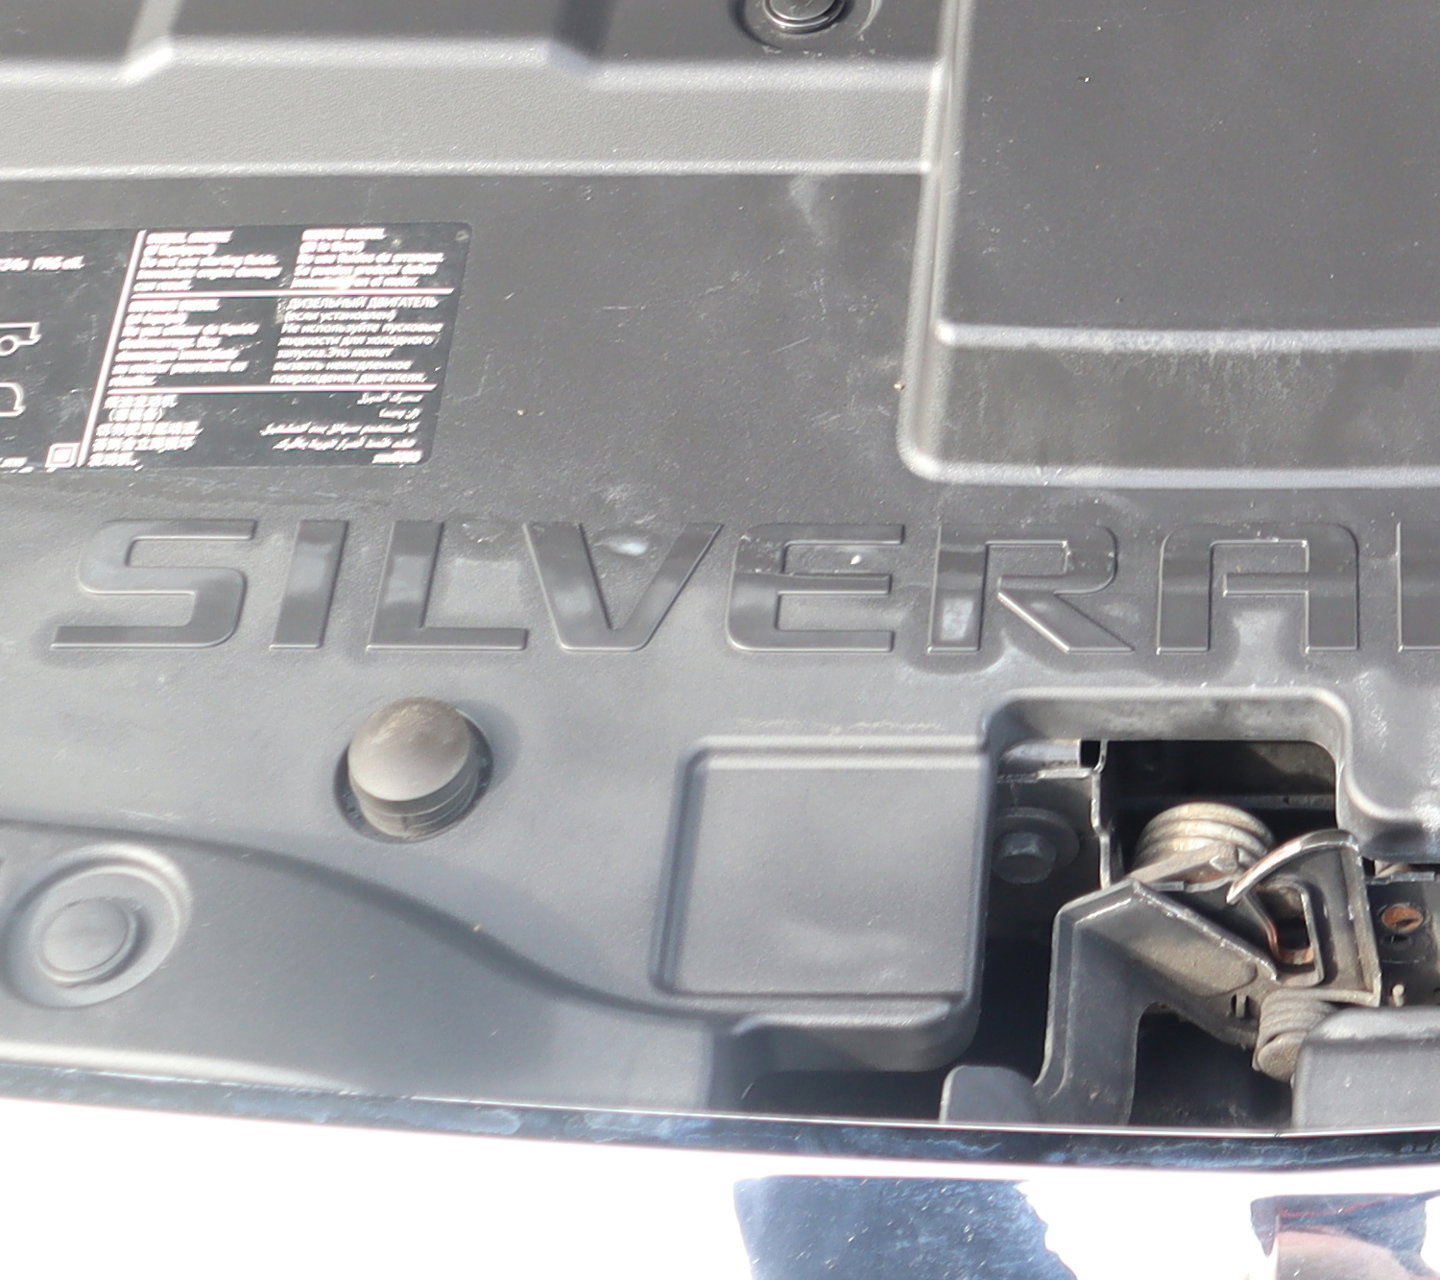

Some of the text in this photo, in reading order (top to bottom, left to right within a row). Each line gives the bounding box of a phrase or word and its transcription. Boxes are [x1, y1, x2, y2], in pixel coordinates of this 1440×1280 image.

[287, 296, 439, 310] ДИЗЕЛЬНЫЙ ДВИГАТЕЛЬ
[301, 322, 380, 335] используйте
